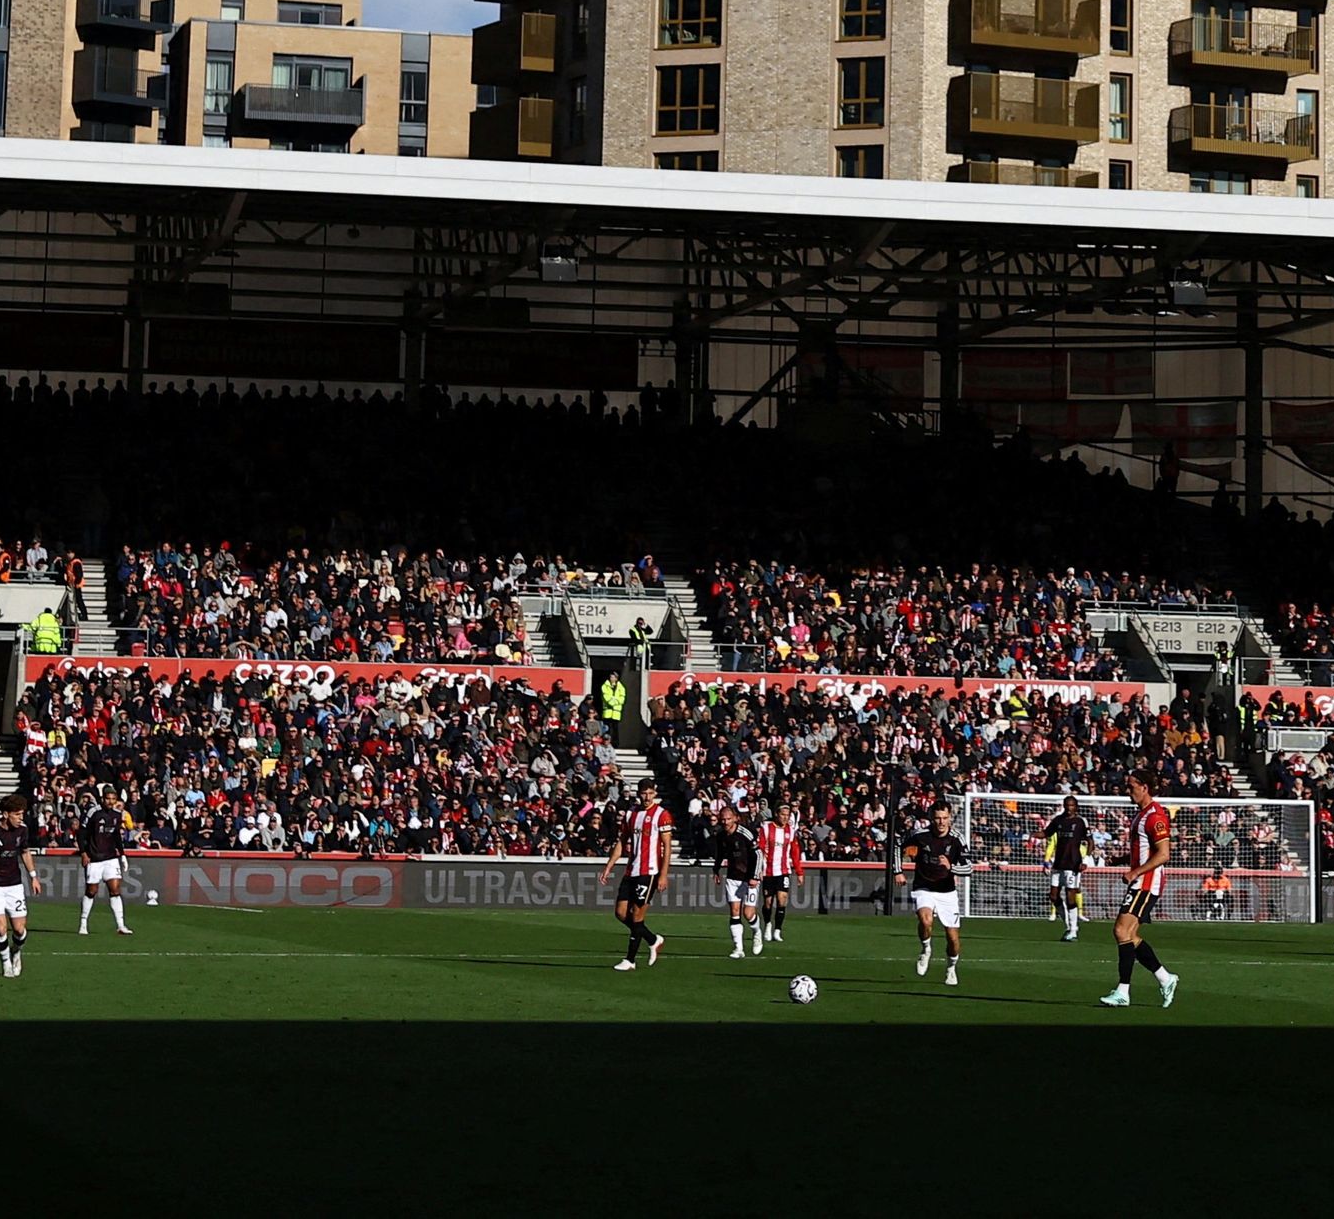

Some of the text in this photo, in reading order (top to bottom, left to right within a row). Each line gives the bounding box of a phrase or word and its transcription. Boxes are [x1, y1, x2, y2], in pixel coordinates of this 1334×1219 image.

[578, 605, 608, 616] E214
[1153, 621, 1225, 634] E213 E212
[1157, 639, 1182, 651] E113
[178, 863, 394, 907] NOCO
[424, 869, 615, 906] ULTRASAFE
